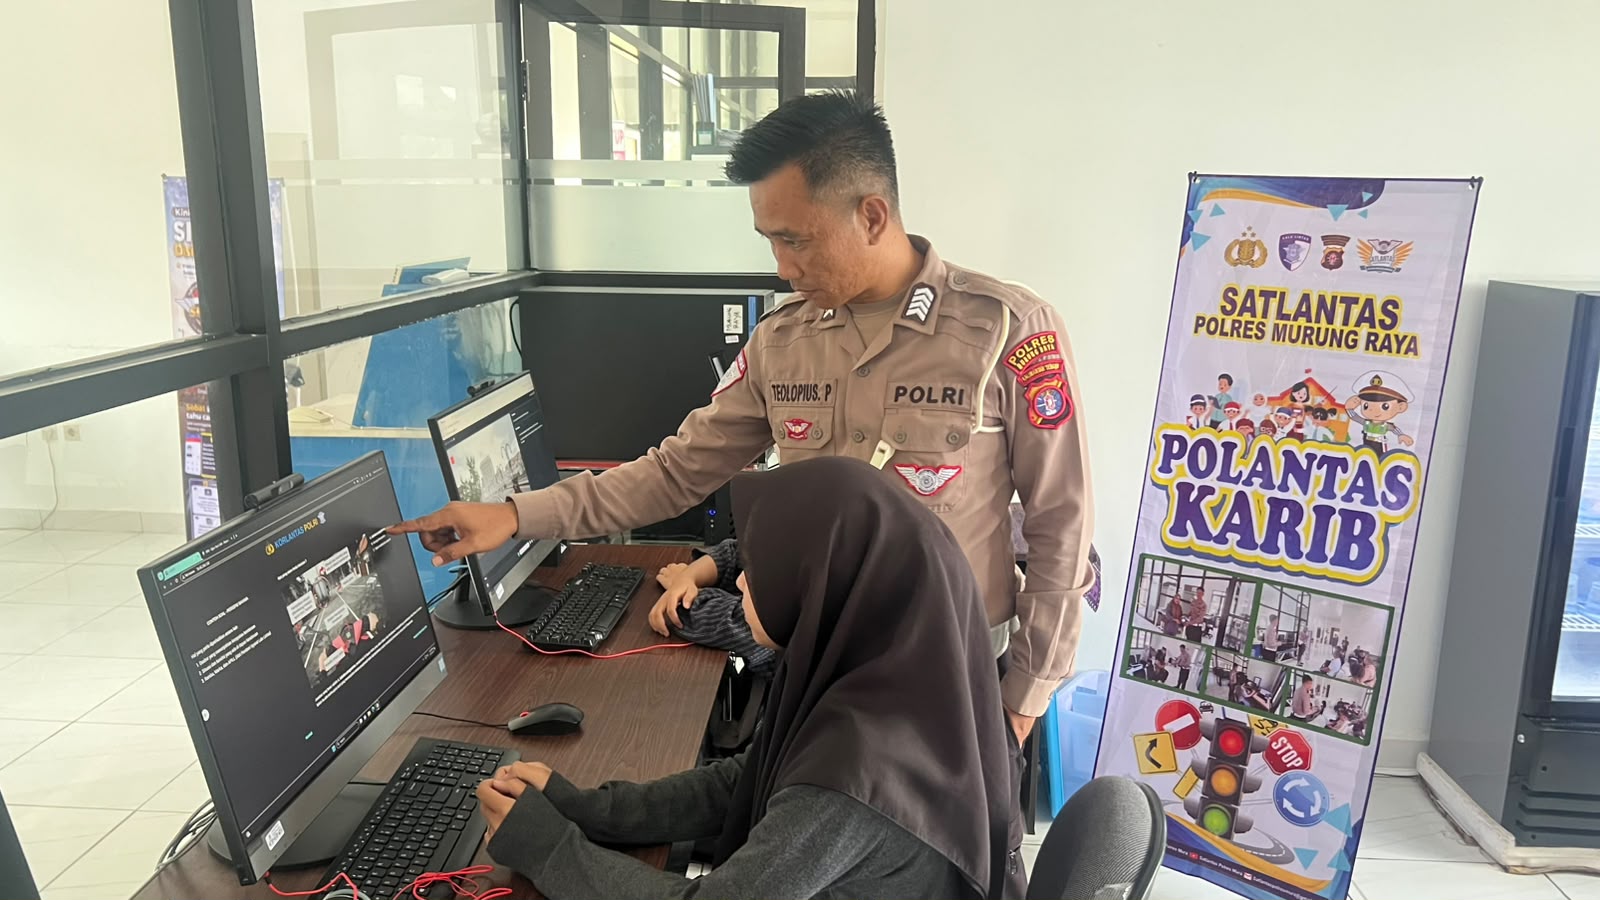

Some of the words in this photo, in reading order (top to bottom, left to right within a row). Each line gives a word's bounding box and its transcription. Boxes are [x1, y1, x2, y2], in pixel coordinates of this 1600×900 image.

[1220, 286, 1400, 331] SATLANTAS
[1008, 334, 1055, 366] POLRES
[1193, 315, 1266, 341] POLRES
[1271, 322, 1359, 350] MURUNG
[1364, 332, 1419, 357] RAYA
[771, 384, 821, 402] TEOLOPIUS.
[825, 384, 832, 402] P
[893, 385, 965, 406] POLRI
[1158, 433, 1413, 511] POLANTAS
[1169, 481, 1376, 571] KARIB
[1271, 736, 1304, 768] STOP
